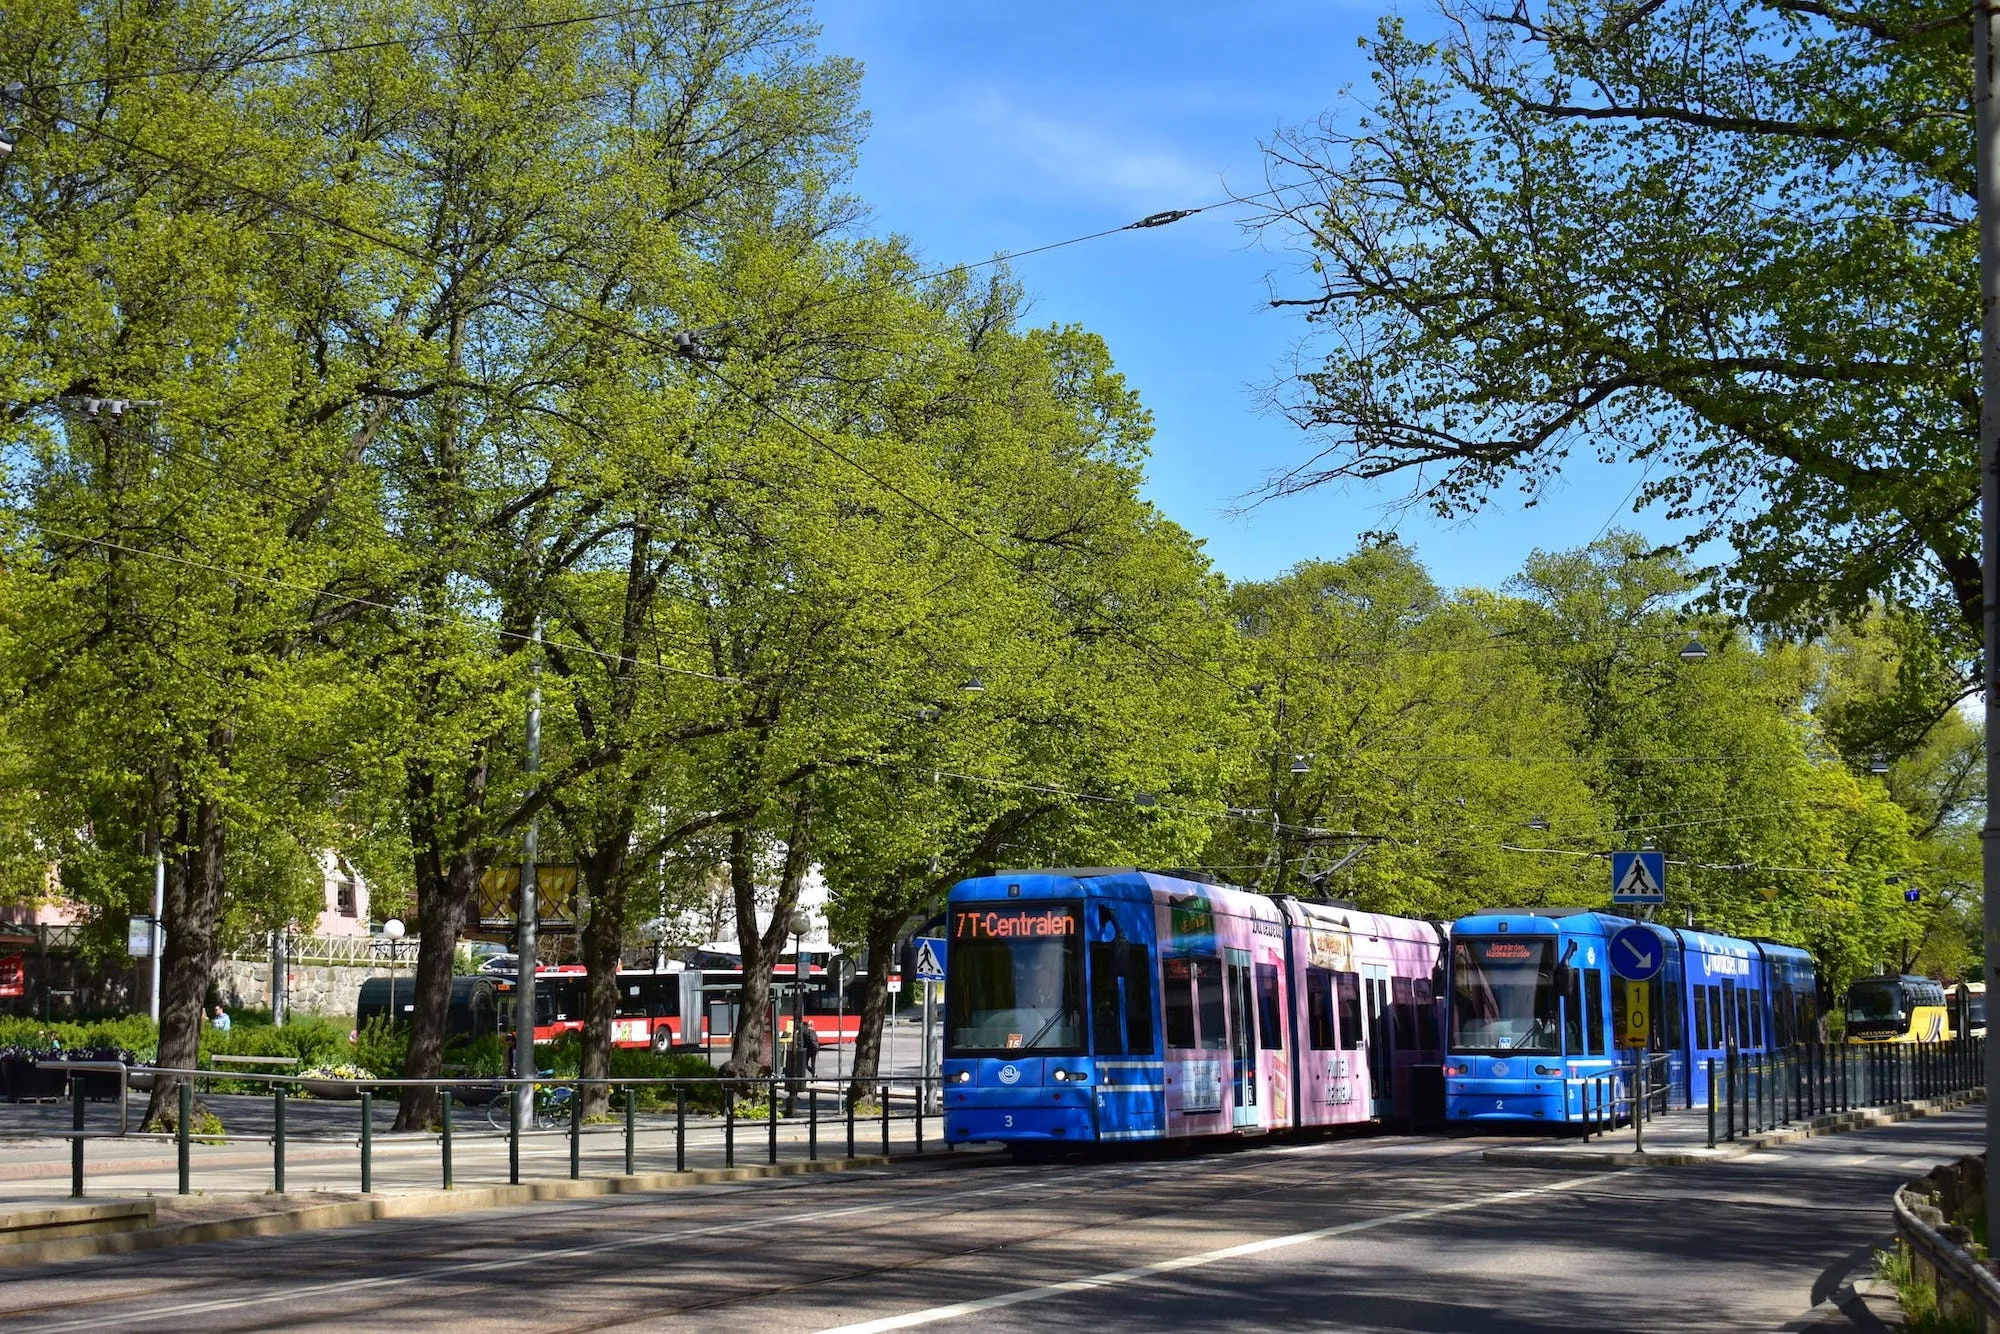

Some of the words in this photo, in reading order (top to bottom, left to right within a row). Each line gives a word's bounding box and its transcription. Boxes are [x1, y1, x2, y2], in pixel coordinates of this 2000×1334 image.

[956, 913, 966, 937] 7
[968, 910, 1075, 938] T-Centralen
[1496, 1099, 1504, 1110] 2
[1004, 1115, 1014, 1127] 3
